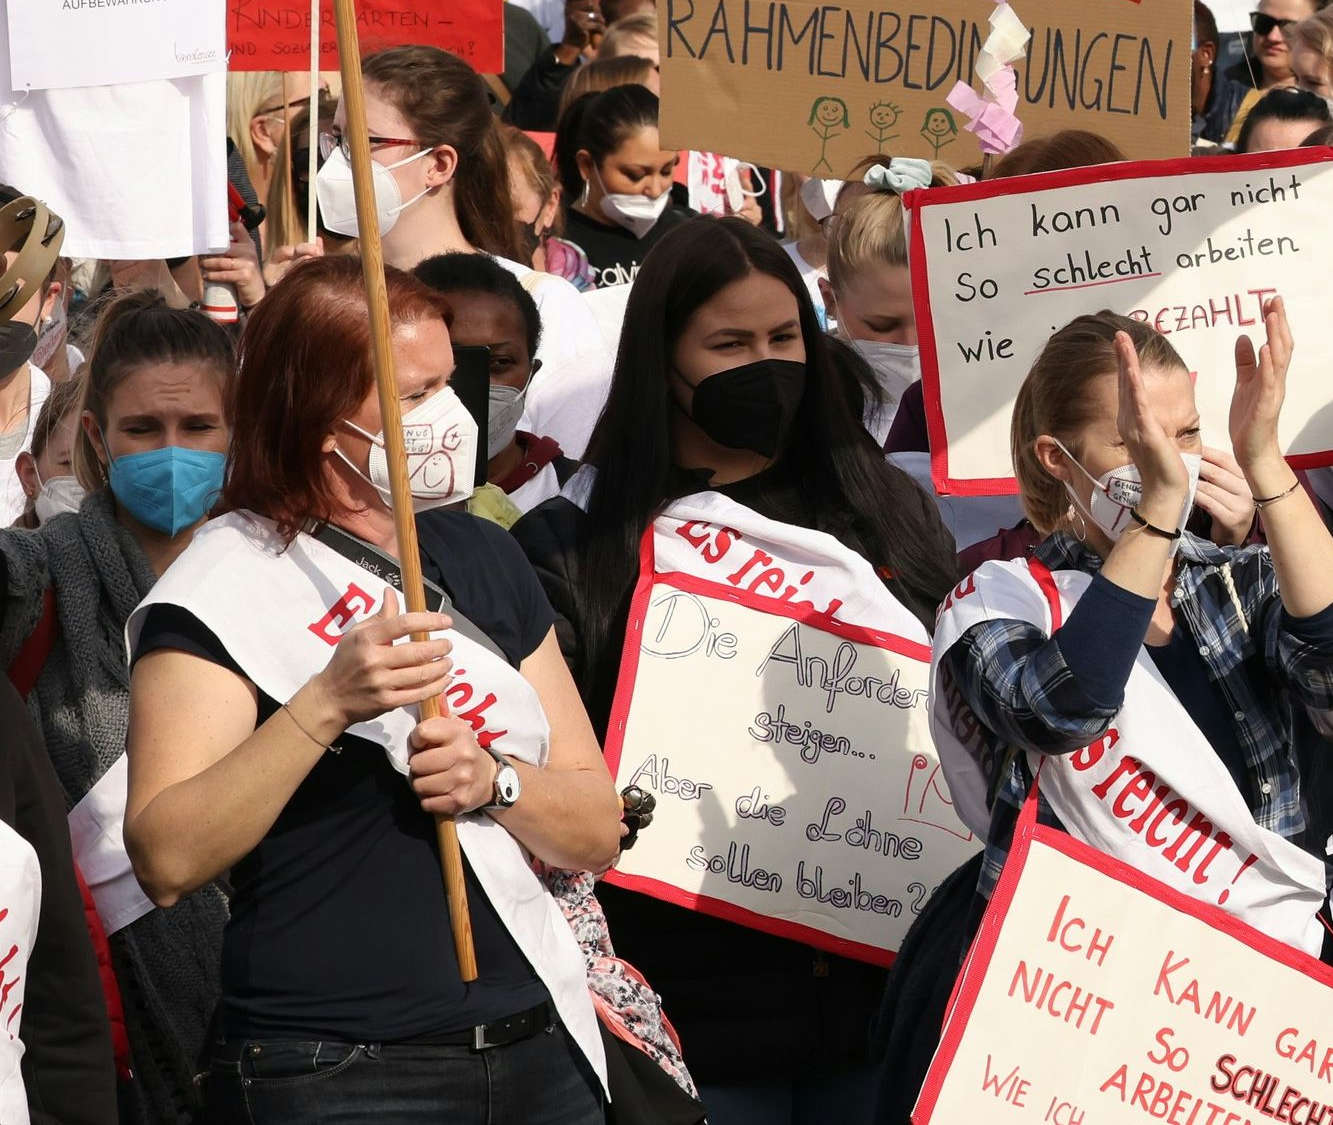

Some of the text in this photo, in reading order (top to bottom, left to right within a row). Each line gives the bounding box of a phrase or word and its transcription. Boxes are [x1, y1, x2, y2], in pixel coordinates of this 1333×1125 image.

[945, 174, 1303, 253] Ich kann gar nicht
[956, 229, 1300, 302] So schlecht arbeiten
[957, 330, 1015, 364] wie
[1129, 288, 1277, 335] BEZAHLT
[356, 557, 382, 576] Jack
[639, 590, 738, 660] Die
[748, 704, 877, 765] steigen...
[629, 753, 923, 862] Aber die Löhne
[686, 842, 783, 894] sollen
[796, 862, 903, 919] bleiben
[1007, 959, 1115, 1036] NICHT
[1047, 894, 1115, 968] ICH
[1153, 948, 1259, 1037] KANN
[981, 1053, 1032, 1109] WIE
[1100, 1063, 1253, 1125] ARBEIT
